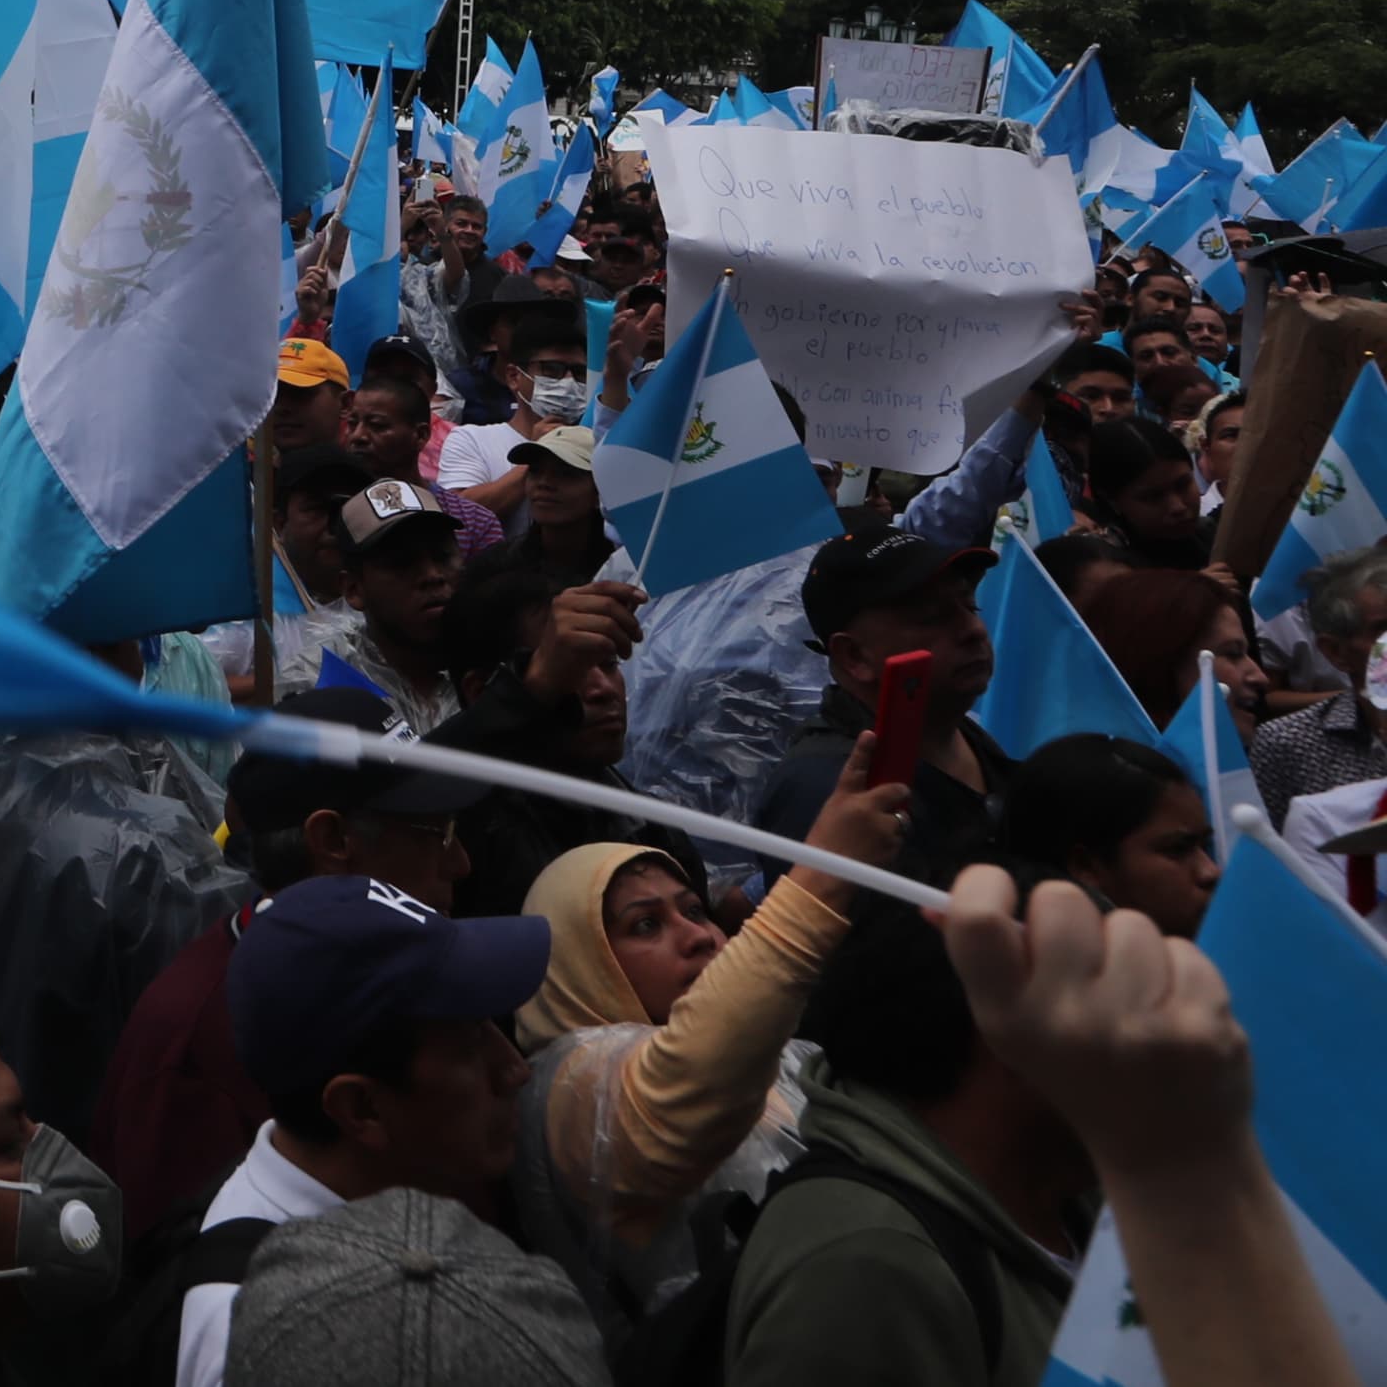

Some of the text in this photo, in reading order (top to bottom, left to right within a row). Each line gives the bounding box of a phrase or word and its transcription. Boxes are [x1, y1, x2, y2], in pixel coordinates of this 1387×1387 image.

[699, 145, 984, 227] Que viva el pueblo
[718, 207, 778, 263] Que
[804, 238, 861, 262] viva
[875, 242, 905, 269] la
[759, 300, 882, 334] gobierno
[805, 327, 929, 366] el pueblo
